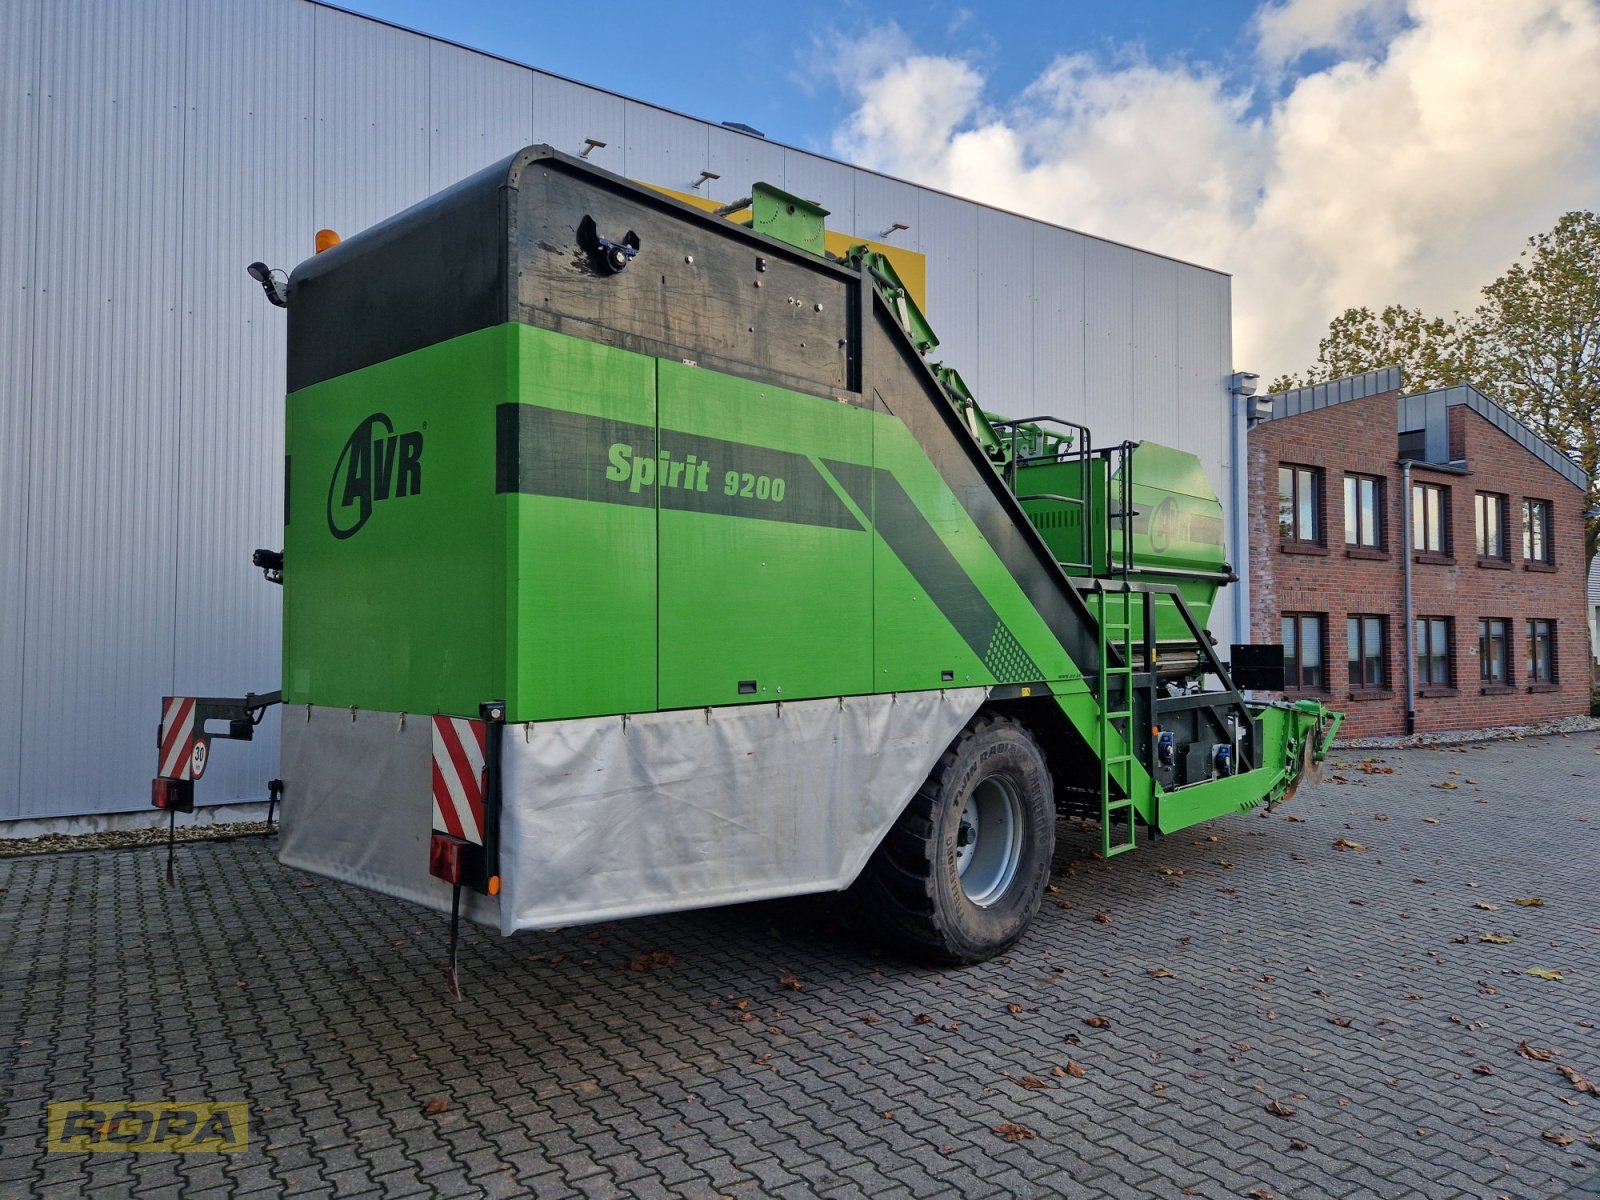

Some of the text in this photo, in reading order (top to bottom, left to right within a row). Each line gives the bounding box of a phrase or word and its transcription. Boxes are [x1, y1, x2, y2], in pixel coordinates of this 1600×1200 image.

[327, 412, 424, 540] AVR
[606, 443, 785, 502] Spirit 9200
[195, 746, 204, 761] 30
[953, 761, 978, 807] TWIN
[946, 836, 964, 921] TRELLEBORG
